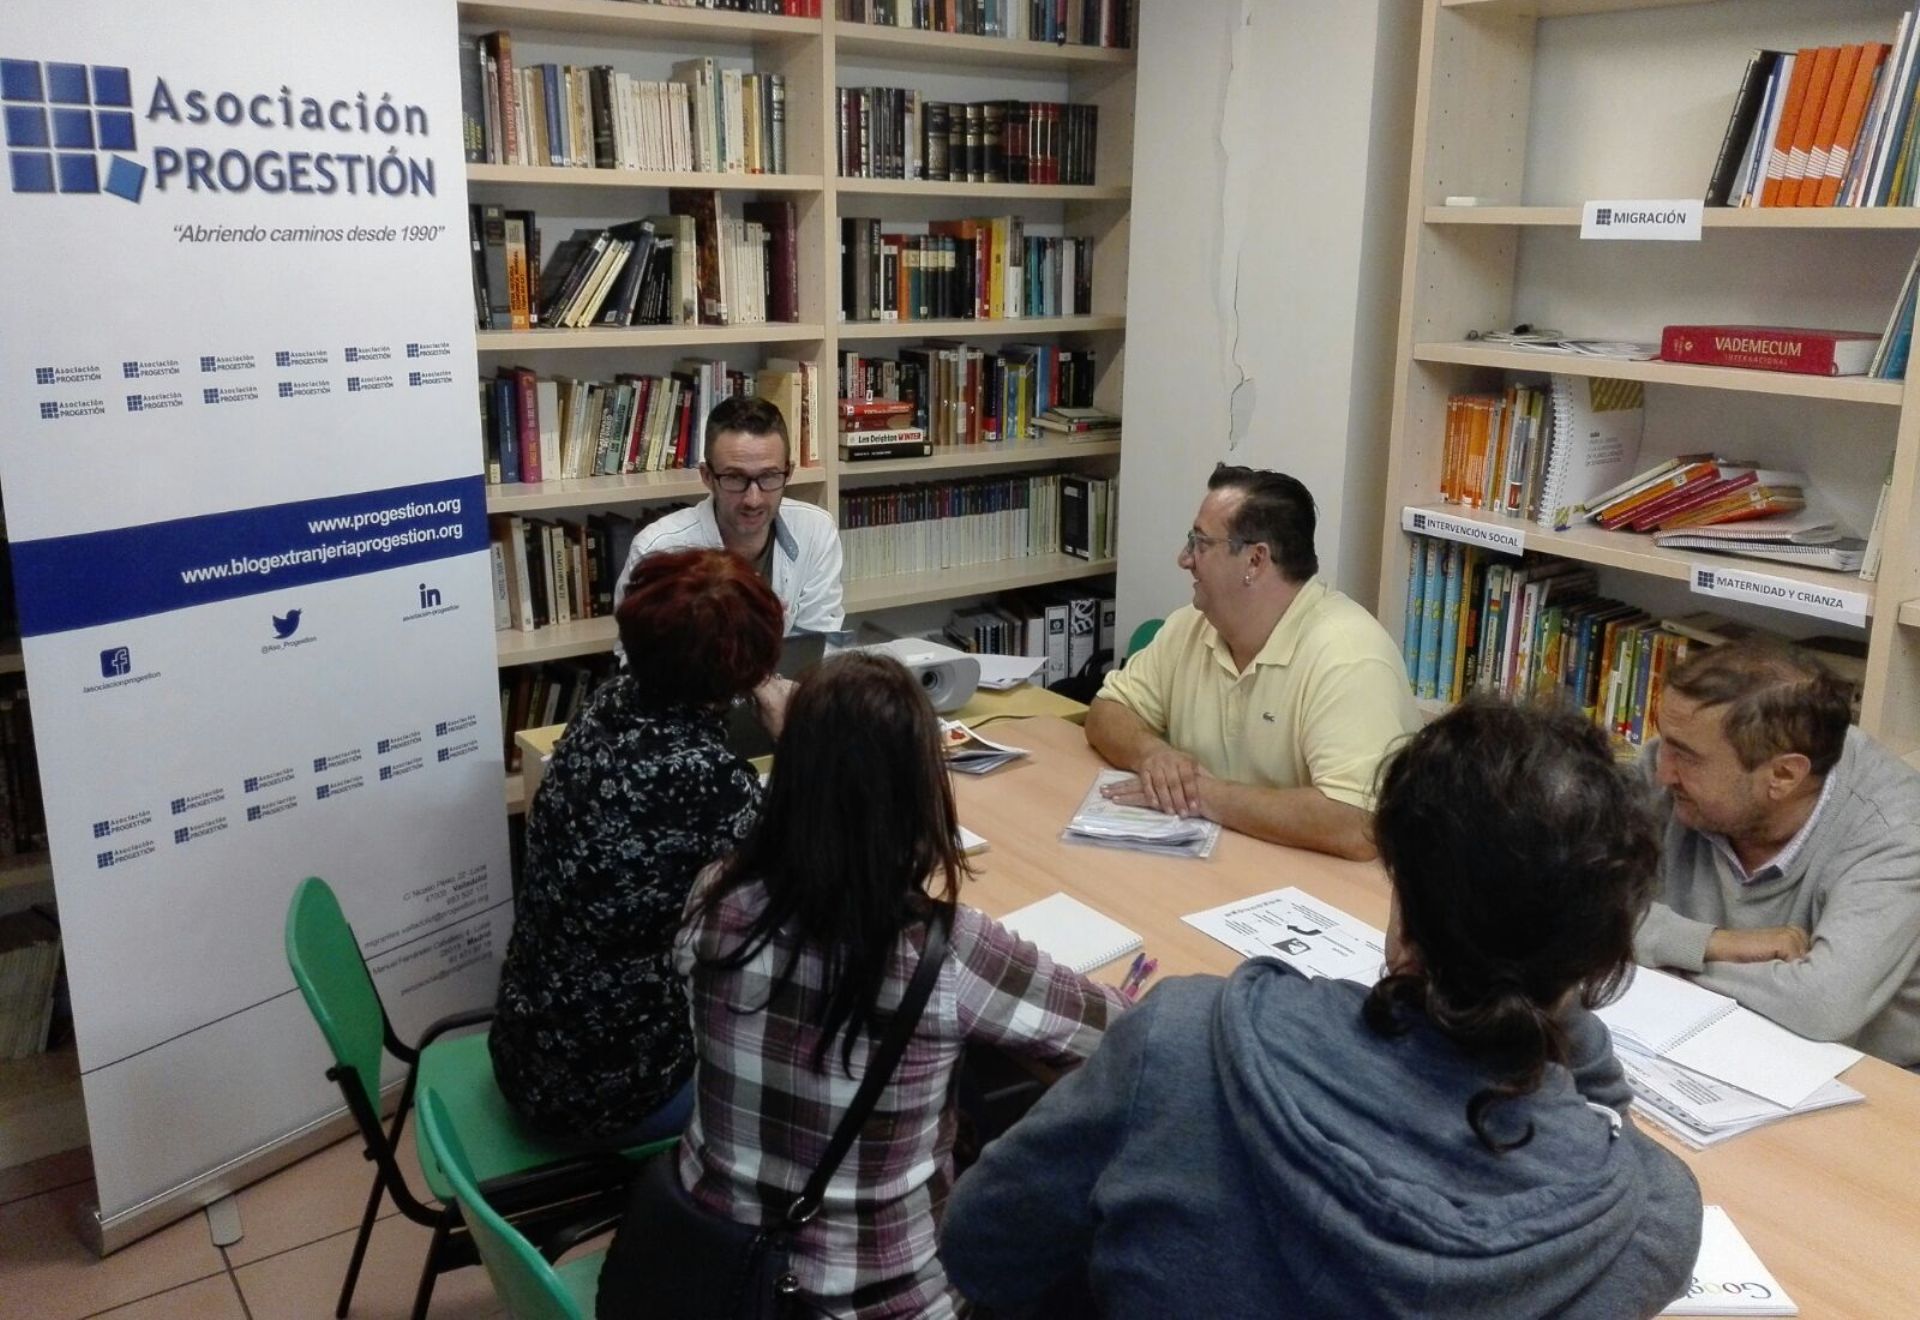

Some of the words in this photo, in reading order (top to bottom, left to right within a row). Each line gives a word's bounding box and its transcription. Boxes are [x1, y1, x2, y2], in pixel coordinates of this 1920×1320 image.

[145, 76, 430, 136] Asociación
[153, 145, 436, 197] PROGESTIÓN
[1613, 209, 1687, 225] MIGRACIÓN
[270, 226, 343, 242] caminos
[347, 225, 396, 242] desde
[1715, 337, 1802, 357] VADEMECUM
[54, 366, 100, 375] Asociación
[140, 367, 180, 377] PROGESTIÓN
[217, 361, 255, 370] PROGESTIÓN
[56, 373, 101, 383] PROGESTIÓN
[59, 399, 104, 409] Asociación
[144, 399, 183, 409] PROGESTIÓN
[220, 392, 258, 402] PROGESTIÓN
[60, 407, 105, 417] PROGESTIÓN
[898, 432, 921, 440] WINTER
[308, 497, 461, 534] www.progestion.org
[1427, 517, 1486, 540] INTERVENCIÓN
[1489, 532, 1518, 547] SOCIAL
[181, 522, 464, 584] www.blogextranjeriaprogestion.org
[1716, 575, 1785, 598] MATERNIDAD
[1789, 590, 1796, 599] Y
[1798, 592, 1844, 609] CRIANZA
[111, 817, 152, 833] PROGESTIÓN
[115, 847, 155, 864] PROGESTIÓN
[1686, 1277, 1772, 1300] Goog
